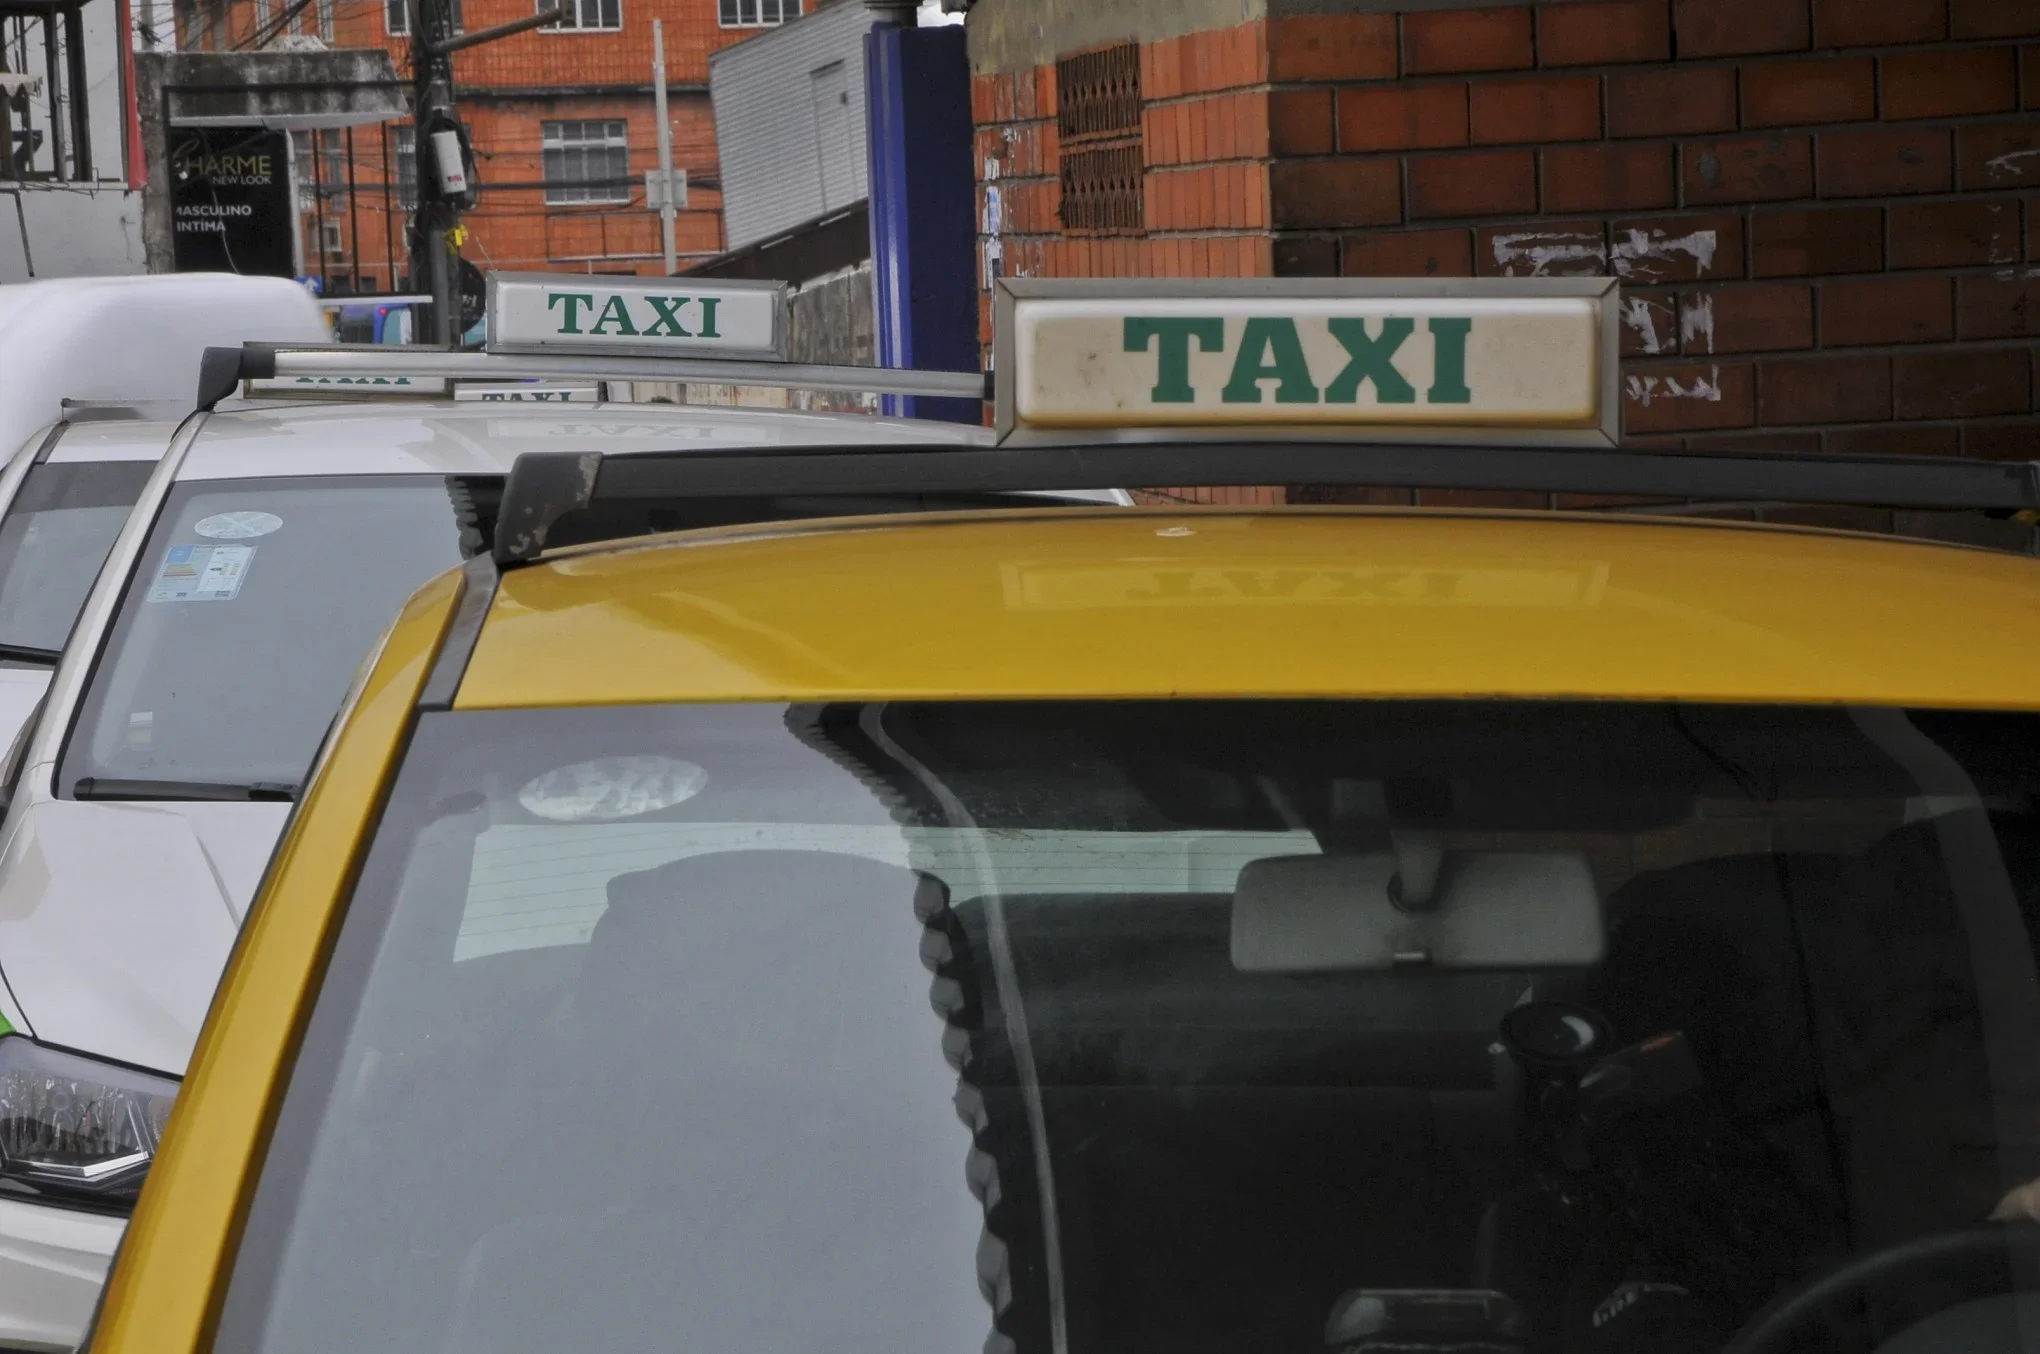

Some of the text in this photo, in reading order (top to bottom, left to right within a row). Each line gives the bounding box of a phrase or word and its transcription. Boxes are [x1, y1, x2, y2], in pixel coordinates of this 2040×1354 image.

[213, 175, 271, 184] NEW LOOK
[548, 294, 721, 338] TAXI
[1123, 317, 1472, 403] TAXI
